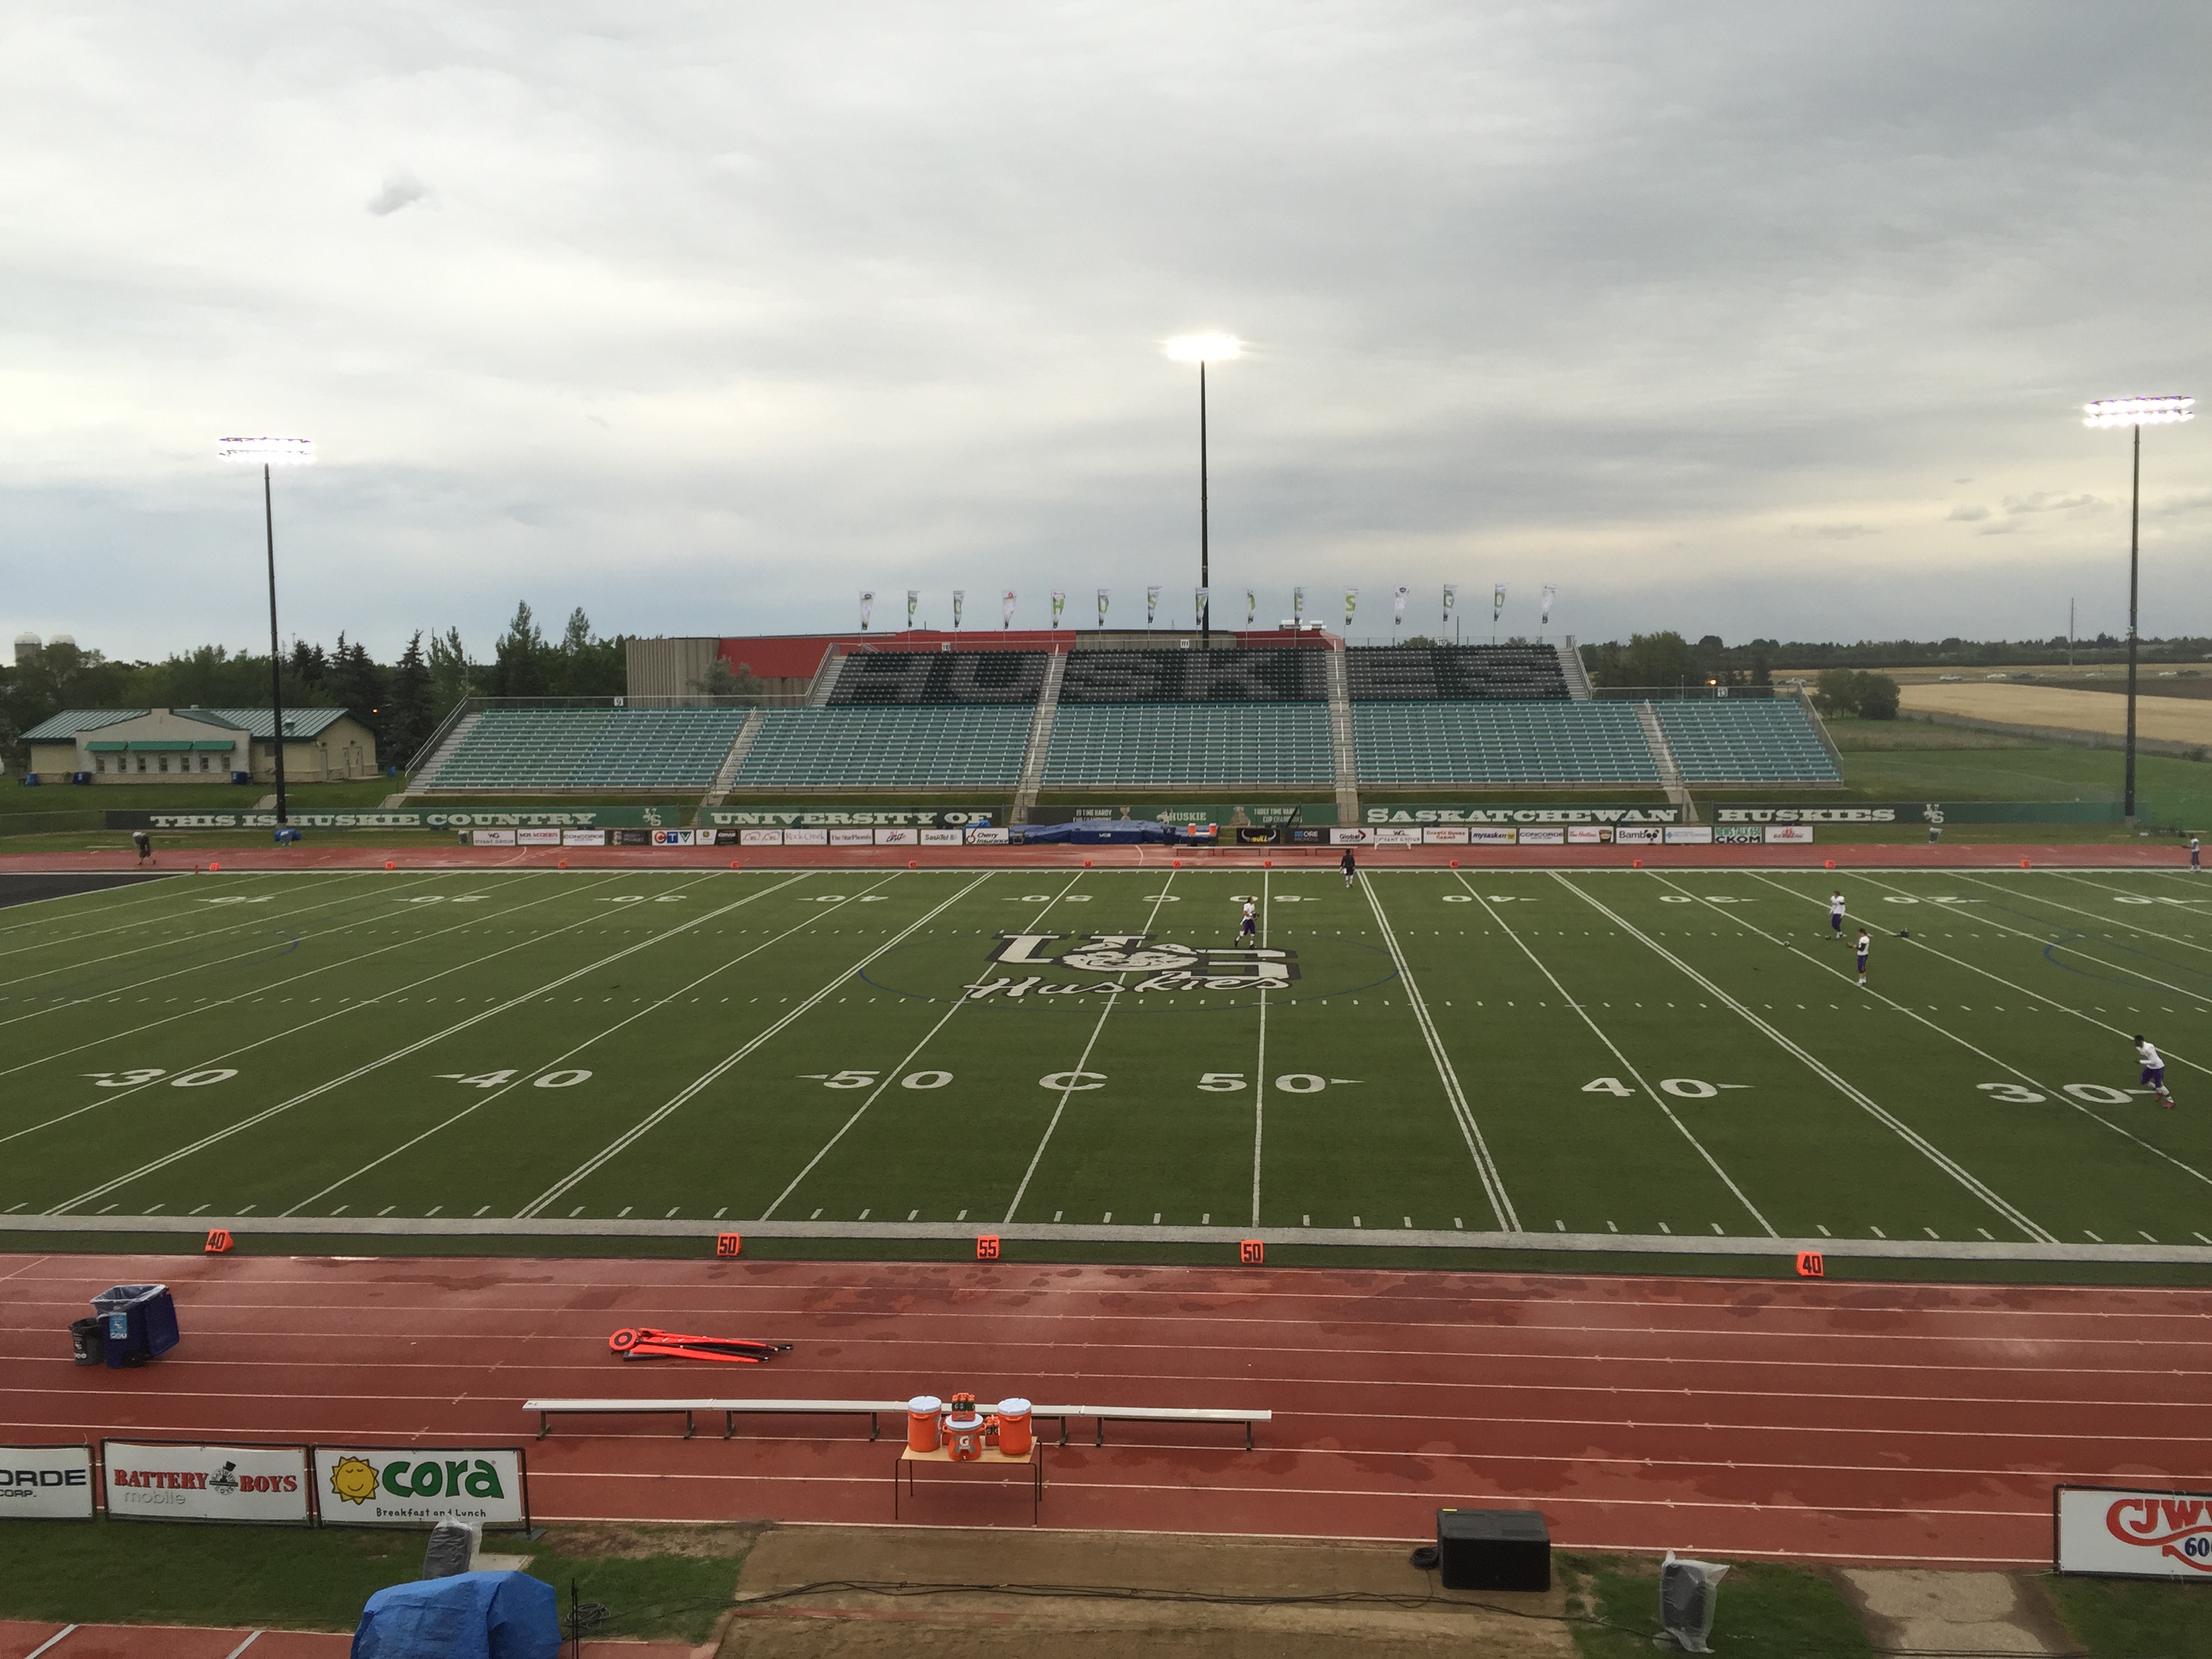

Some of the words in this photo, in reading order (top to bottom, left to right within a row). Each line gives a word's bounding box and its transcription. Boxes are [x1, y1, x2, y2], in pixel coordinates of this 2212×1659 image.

[150, 815, 237, 827] THIS
[242, 815, 277, 827] IS
[285, 814, 420, 826] HUSKIE
[427, 813, 596, 825] COUNTRY
[710, 813, 938, 825] UNIVERSITY
[944, 813, 993, 825] OF
[1169, 812, 1207, 821] HUSKIE
[1368, 808, 1678, 823] SASKATCHEWAN
[1718, 809, 1896, 821] HUSKIES
[655, 832, 692, 844] CTV
[963, 971, 1289, 998] Huskies
[94, 1068, 239, 1088] 30
[458, 1069, 594, 1088] 40
[822, 1070, 954, 1089] 50
[1038, 1071, 1108, 1091] C
[1197, 1073, 1326, 1093] 50
[1581, 1077, 1718, 1098] 40
[1976, 1082, 2133, 1103] 30
[207, 1232, 226, 1250] 40
[719, 1236, 737, 1254] 50
[979, 1240, 997, 1257] 55
[1243, 1244, 1261, 1262] 50
[1803, 1255, 1822, 1274] 40
[959, 1436, 970, 1446] G
[113, 1469, 209, 1491] BATTERY
[239, 1475, 298, 1493] BOYS
[382, 1460, 505, 1499] cora
[124, 1490, 186, 1506] mobile
[376, 1507, 430, 1517] Breakfast
[455, 1509, 487, 1518] Lunch
[2185, 1538, 2212, 1557] 60
